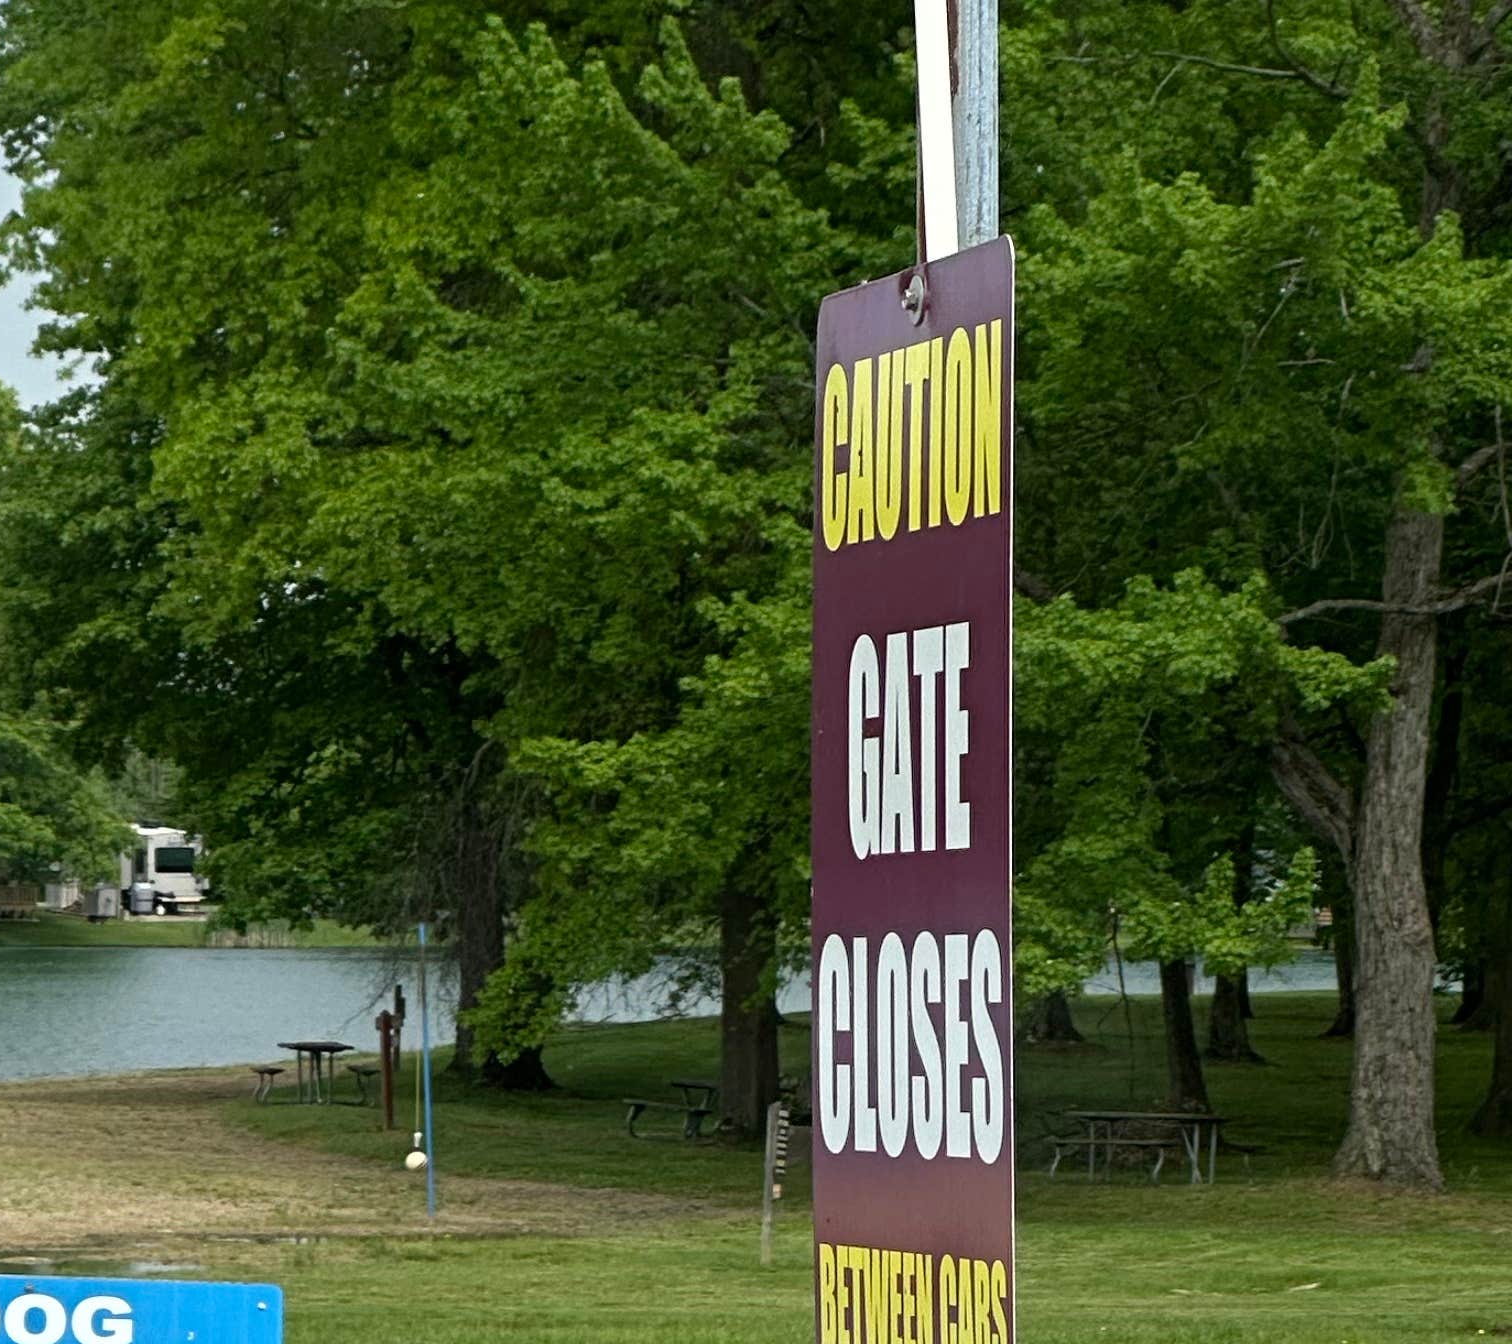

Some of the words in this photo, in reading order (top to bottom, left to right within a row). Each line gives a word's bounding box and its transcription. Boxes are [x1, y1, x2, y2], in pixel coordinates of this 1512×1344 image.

[822, 319, 1002, 552] CAUTION
[848, 621, 971, 861] GATE
[818, 928, 1004, 1165] CLOSES
